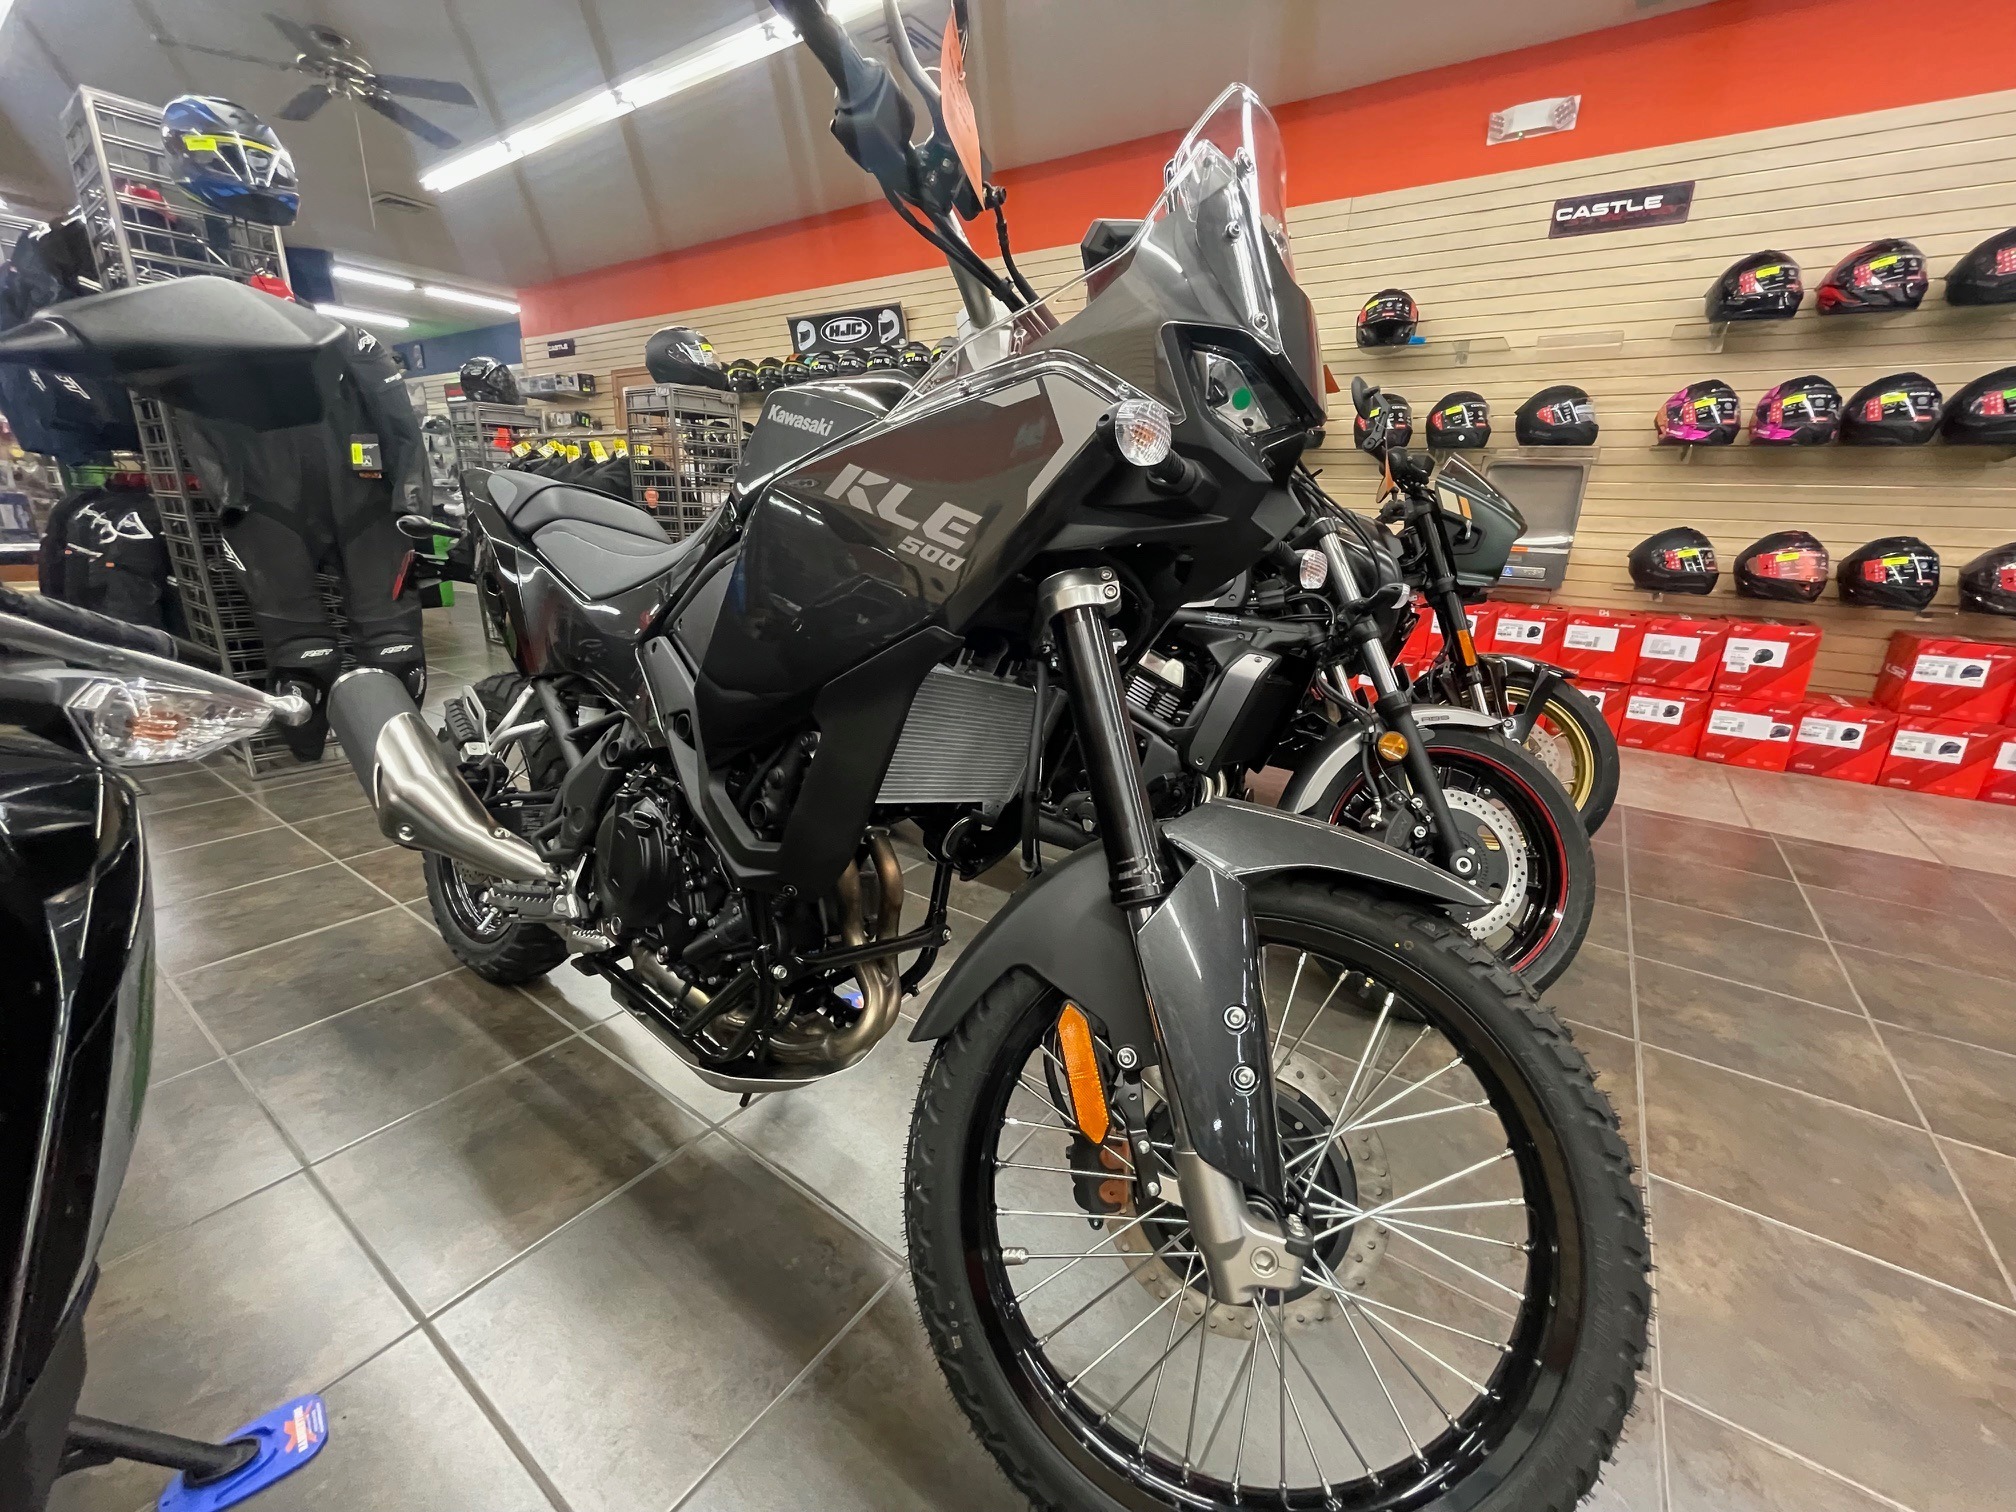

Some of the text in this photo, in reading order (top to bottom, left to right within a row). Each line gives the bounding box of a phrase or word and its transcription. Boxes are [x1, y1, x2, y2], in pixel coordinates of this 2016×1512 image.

[1555, 194, 1665, 222] CASTLE
[828, 321, 864, 338] HJC
[767, 404, 834, 437] Kawasaki
[824, 462, 984, 550] KLE
[897, 535, 967, 572] 500
[300, 648, 334, 659] RST
[380, 644, 413, 655] RST
